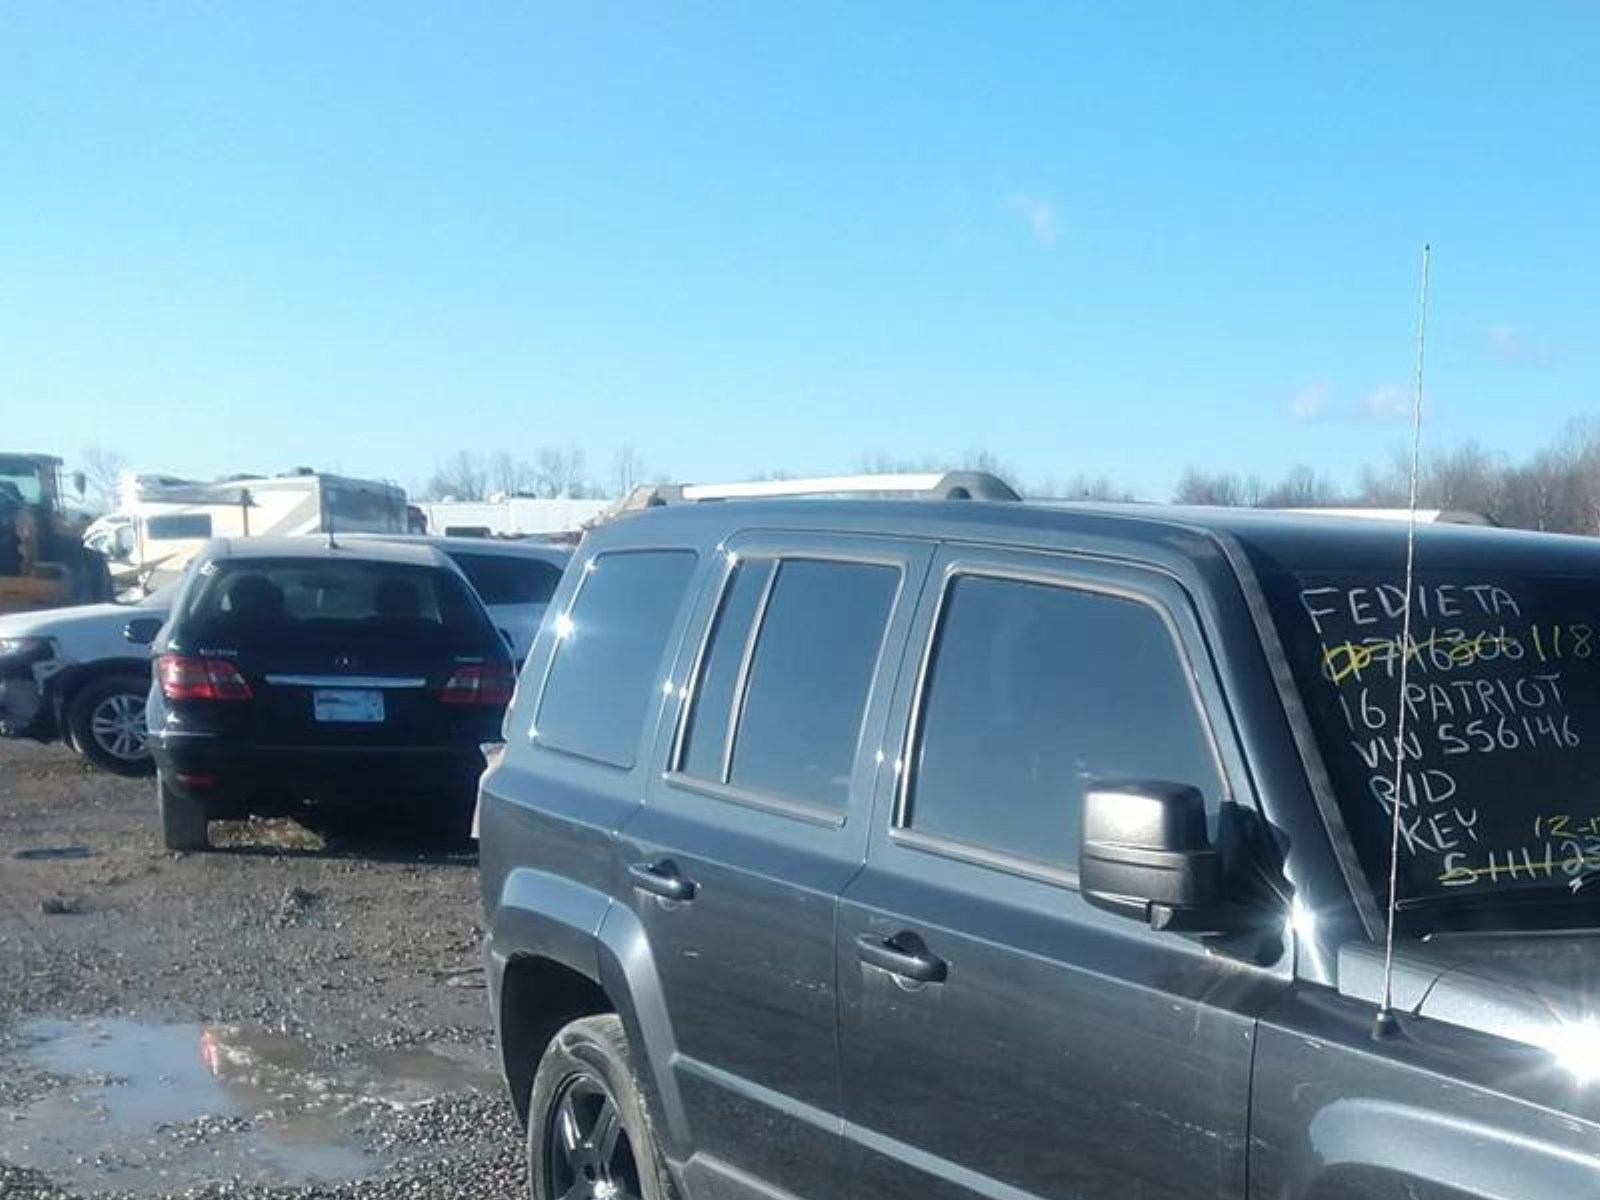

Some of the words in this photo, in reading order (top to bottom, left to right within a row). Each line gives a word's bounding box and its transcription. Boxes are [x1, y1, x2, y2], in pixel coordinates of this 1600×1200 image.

[1340, 687, 1387, 732] 16
[1404, 673, 1562, 722] PATRIOT
[1351, 731, 1424, 769] VIN
[1400, 808, 1478, 855] KEY
